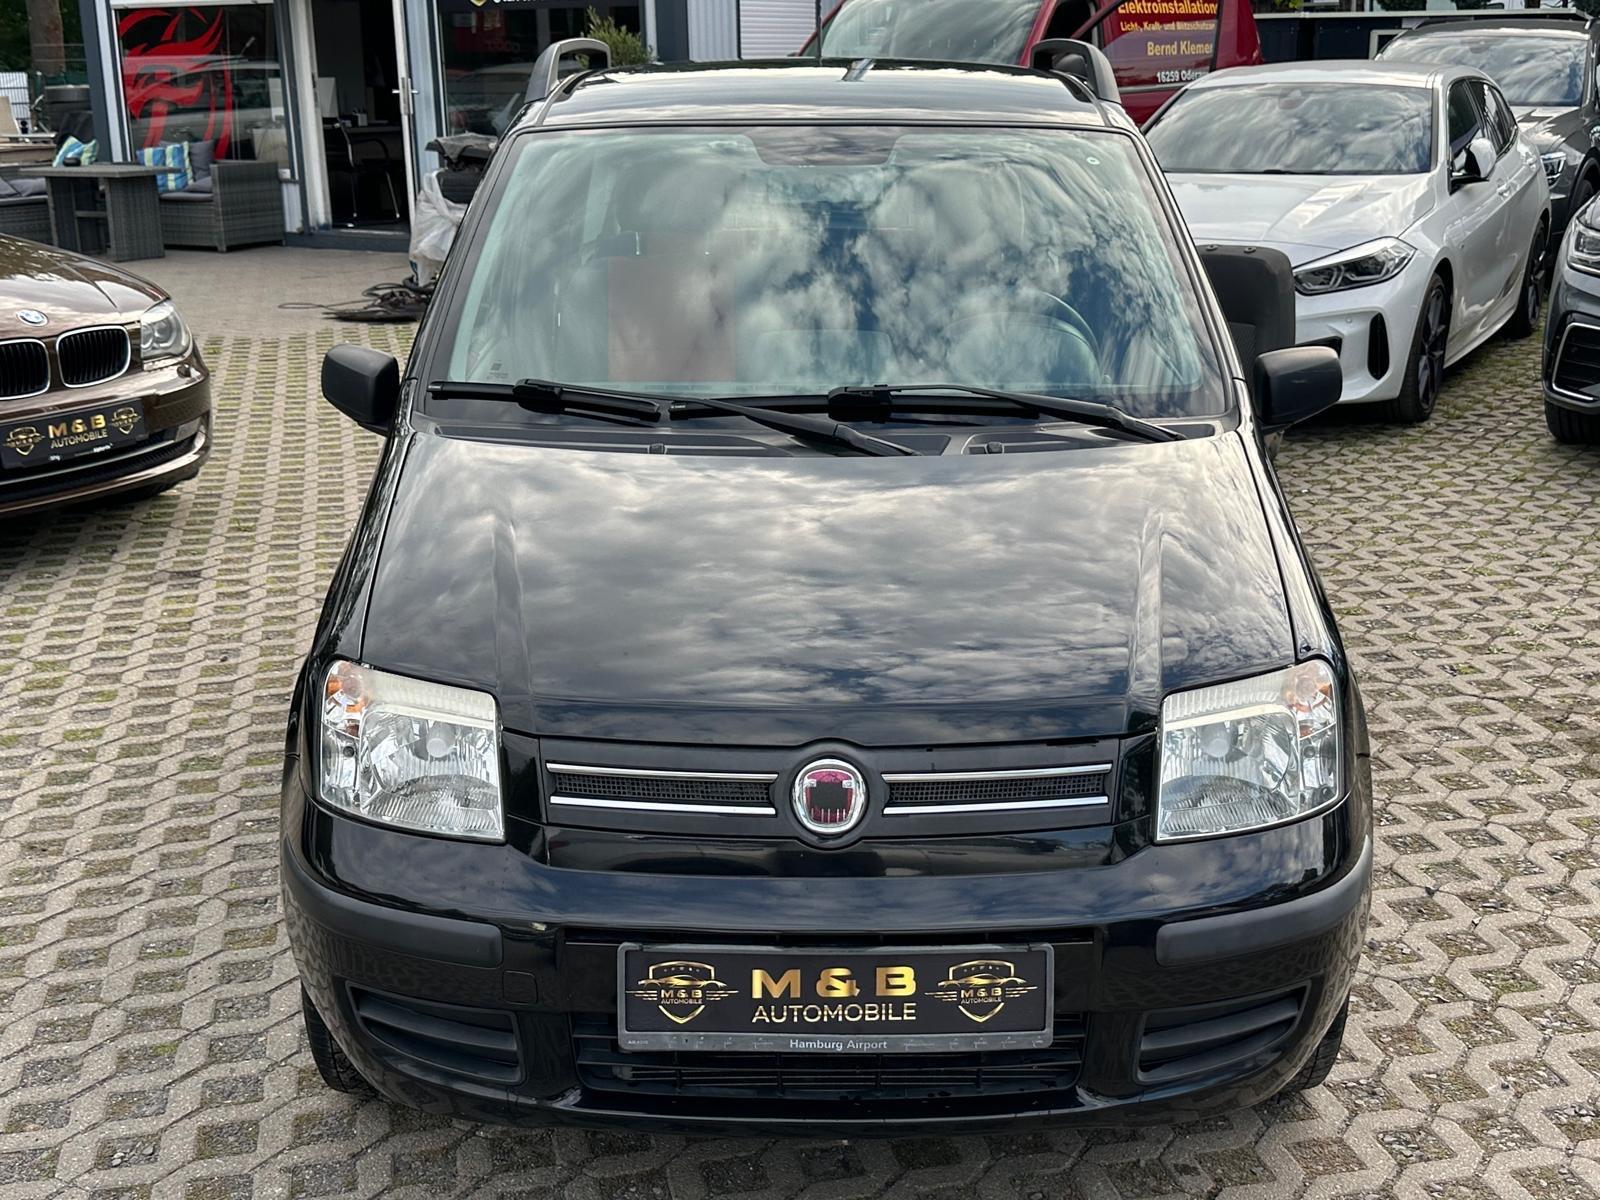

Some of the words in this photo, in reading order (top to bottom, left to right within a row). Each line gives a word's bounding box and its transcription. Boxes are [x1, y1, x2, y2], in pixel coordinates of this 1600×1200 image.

[1147, 41, 1177, 56] Bernd
[1156, 71, 1179, 83] 16259
[48, 422, 67, 438] M
[71, 419, 88, 433] &
[90, 414, 106, 430] B
[50, 429, 108, 448] AUTOMOBILE
[752, 969, 800, 998] M
[816, 967, 860, 998] &
[876, 966, 917, 997] B
[661, 989, 674, 998] M
[677, 989, 689, 998] &
[691, 989, 703, 998] B
[960, 989, 973, 998] M
[977, 988, 989, 998] &
[991, 987, 1002, 996] B
[752, 1003, 917, 1023] AUTOMOBILE
[789, 1038, 843, 1051] Hamburg
[847, 1039, 887, 1050] Airport
